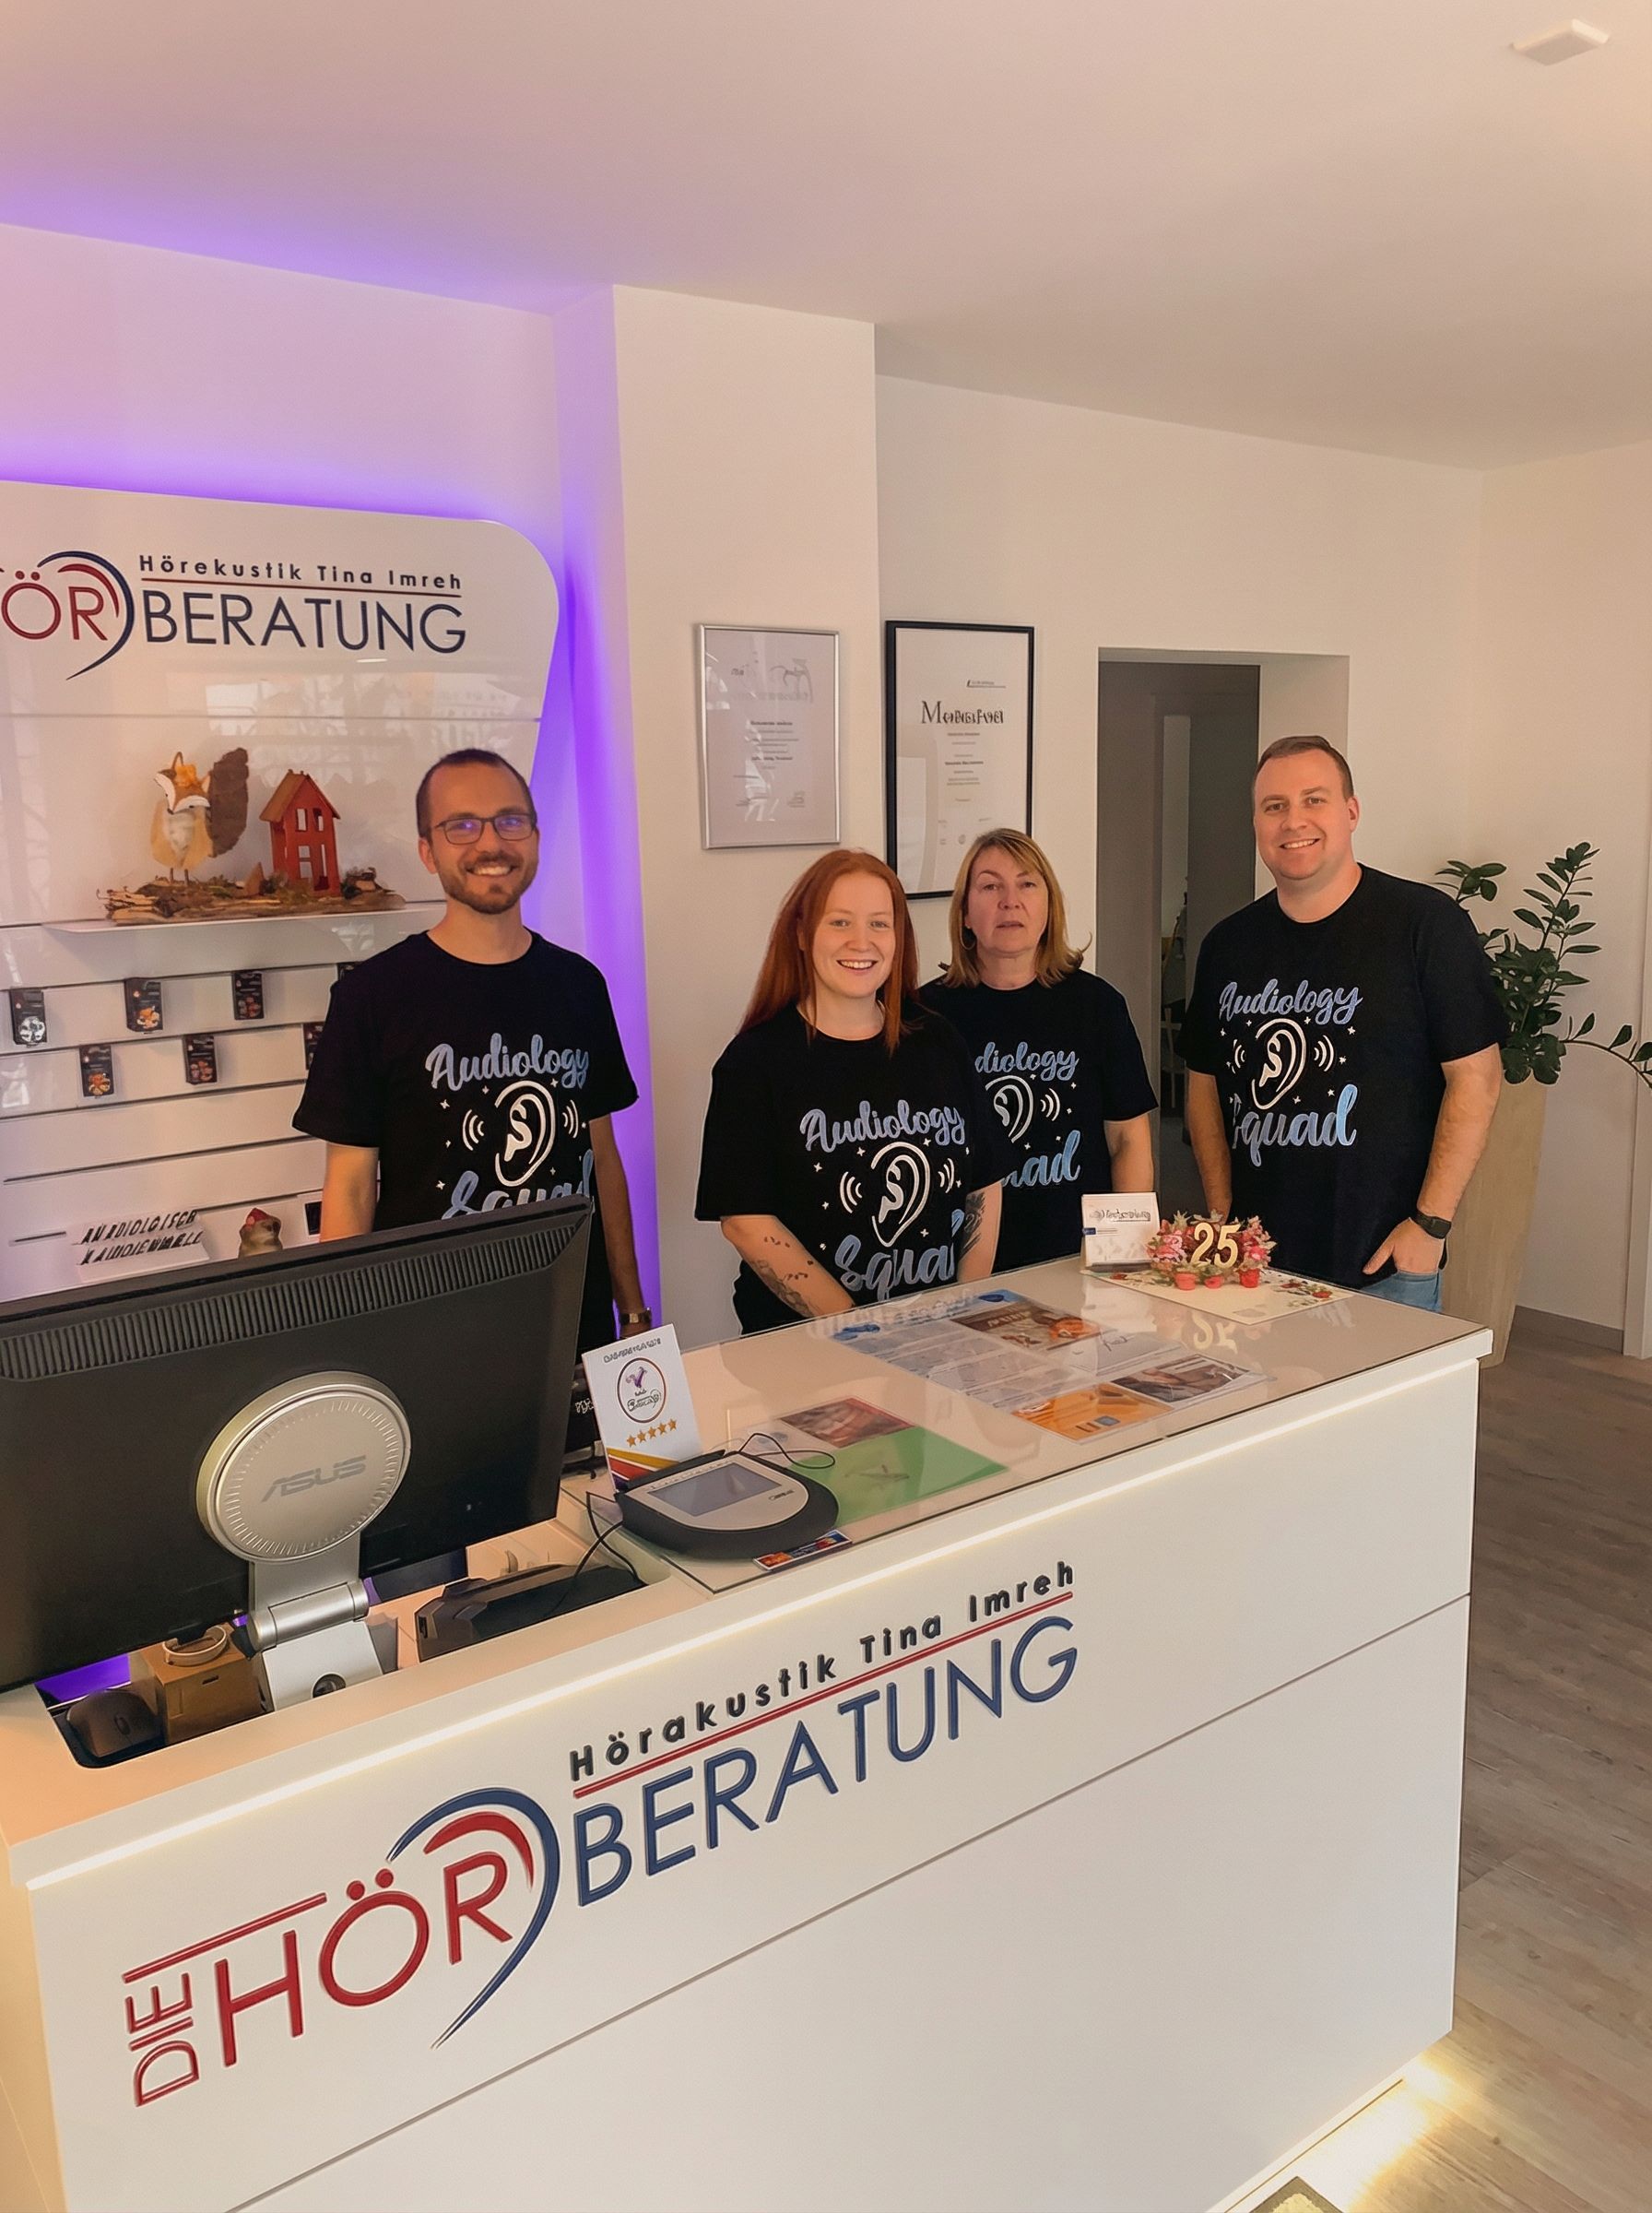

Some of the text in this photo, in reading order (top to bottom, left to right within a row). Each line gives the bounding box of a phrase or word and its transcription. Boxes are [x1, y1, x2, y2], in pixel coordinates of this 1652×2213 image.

[317, 565, 372, 584] Tina
[388, 570, 461, 589] Imreh
[1, 570, 466, 654] ÖR BERATUNG
[1219, 978, 1363, 1025] Audiology
[425, 1033, 589, 1091] Audiology
[974, 1041, 1080, 1081] diology
[799, 1100, 965, 1153] Audiology
[1190, 1222, 1241, 1269] 25
[261, 1454, 367, 1503] ASUS
[570, 1560, 1074, 1781] Hörakustik Tina Imreh
[125, 1972, 199, 2107] DIE
[573, 1615, 1078, 1907] BERATUNG
